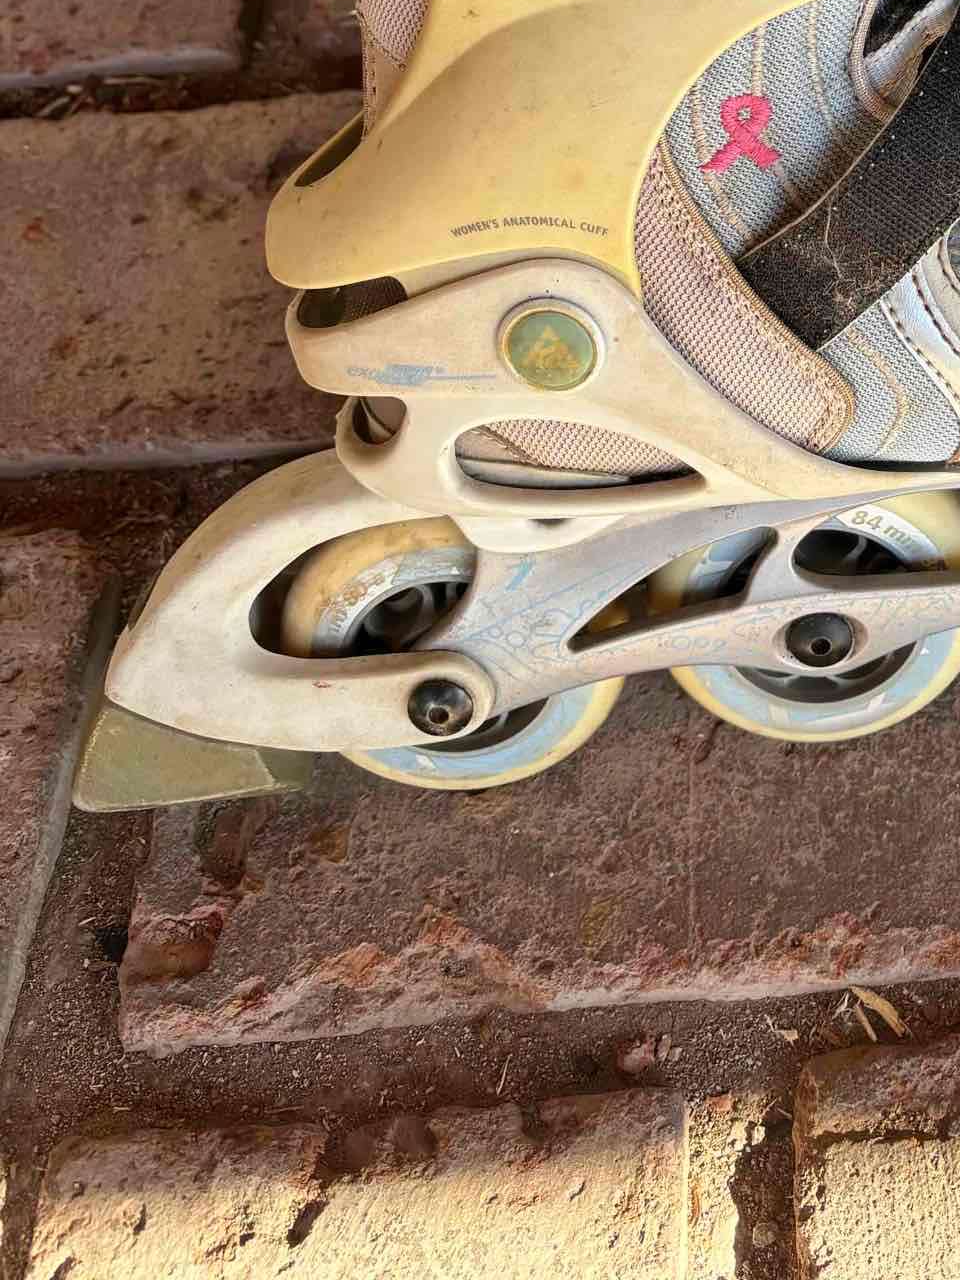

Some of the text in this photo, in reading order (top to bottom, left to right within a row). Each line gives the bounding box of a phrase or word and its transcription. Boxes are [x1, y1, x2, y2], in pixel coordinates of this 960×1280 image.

[450, 216, 609, 237] WOMEN'S ANATOMICAL CUFF
